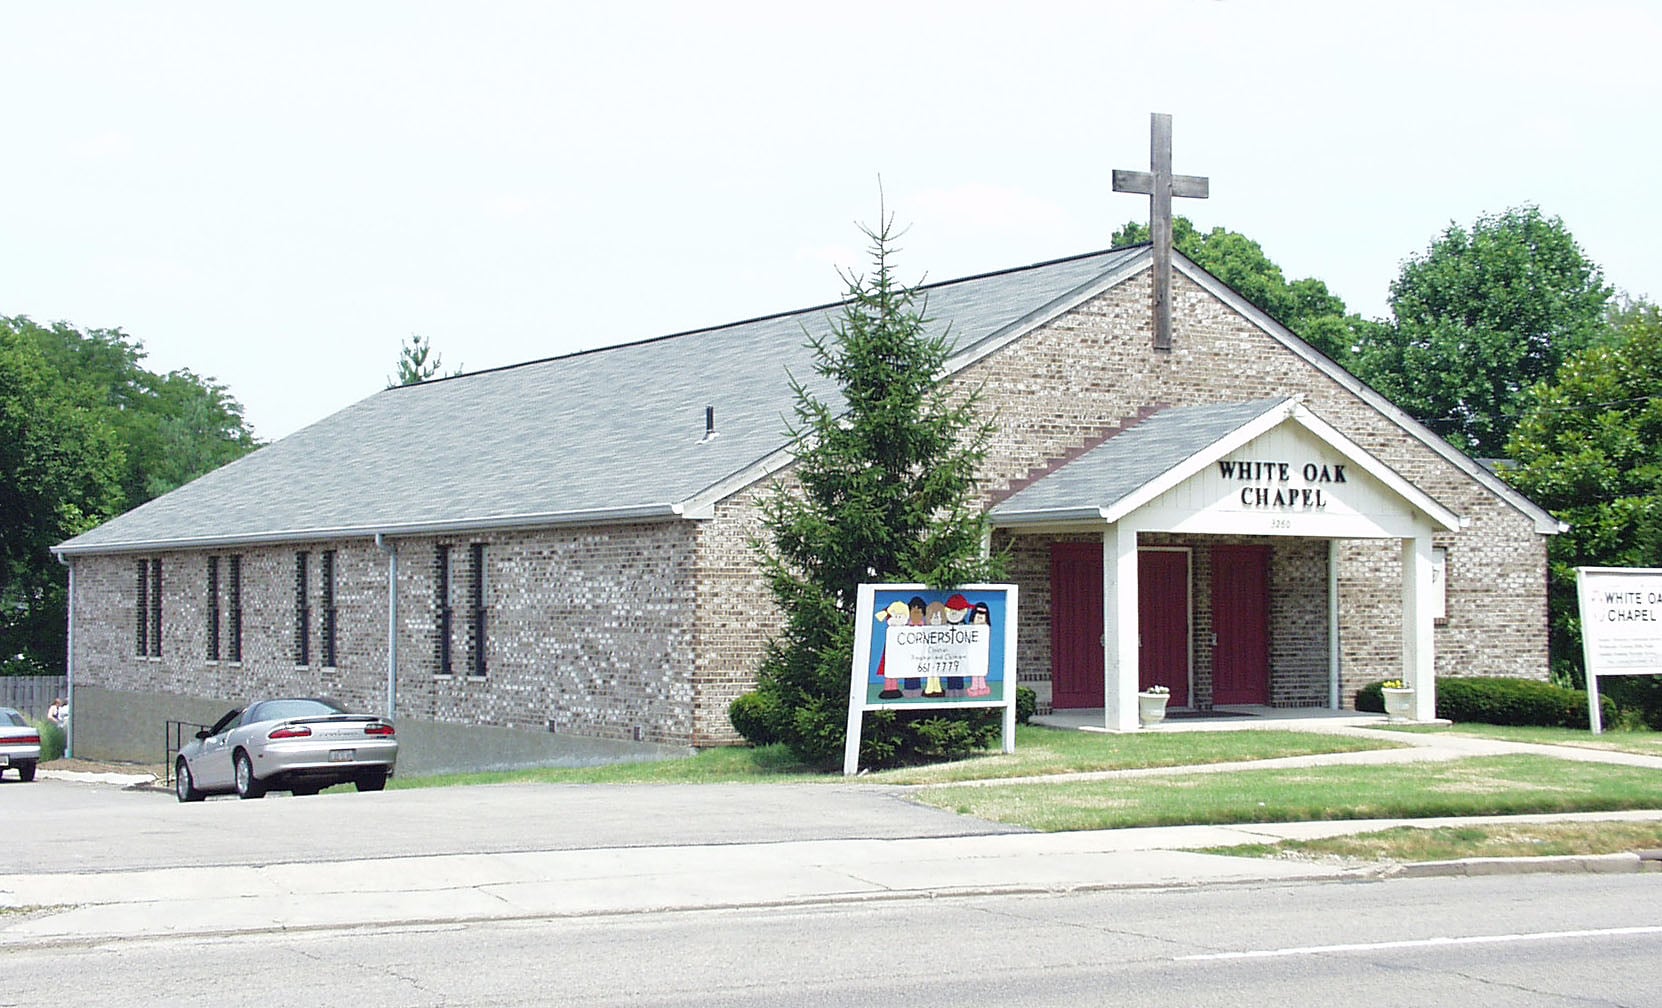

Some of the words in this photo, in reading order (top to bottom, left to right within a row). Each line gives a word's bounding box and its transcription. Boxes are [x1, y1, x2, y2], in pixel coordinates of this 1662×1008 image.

[1218, 460, 1290, 481] WHITE
[1303, 463, 1347, 482] OAK
[1241, 486, 1327, 507] CHAPEL
[1604, 591, 1642, 605] WHITE
[1647, 592, 1662, 605] OA
[1607, 609, 1657, 622] CHAPEL
[896, 627, 979, 646] CORNERSTONE
